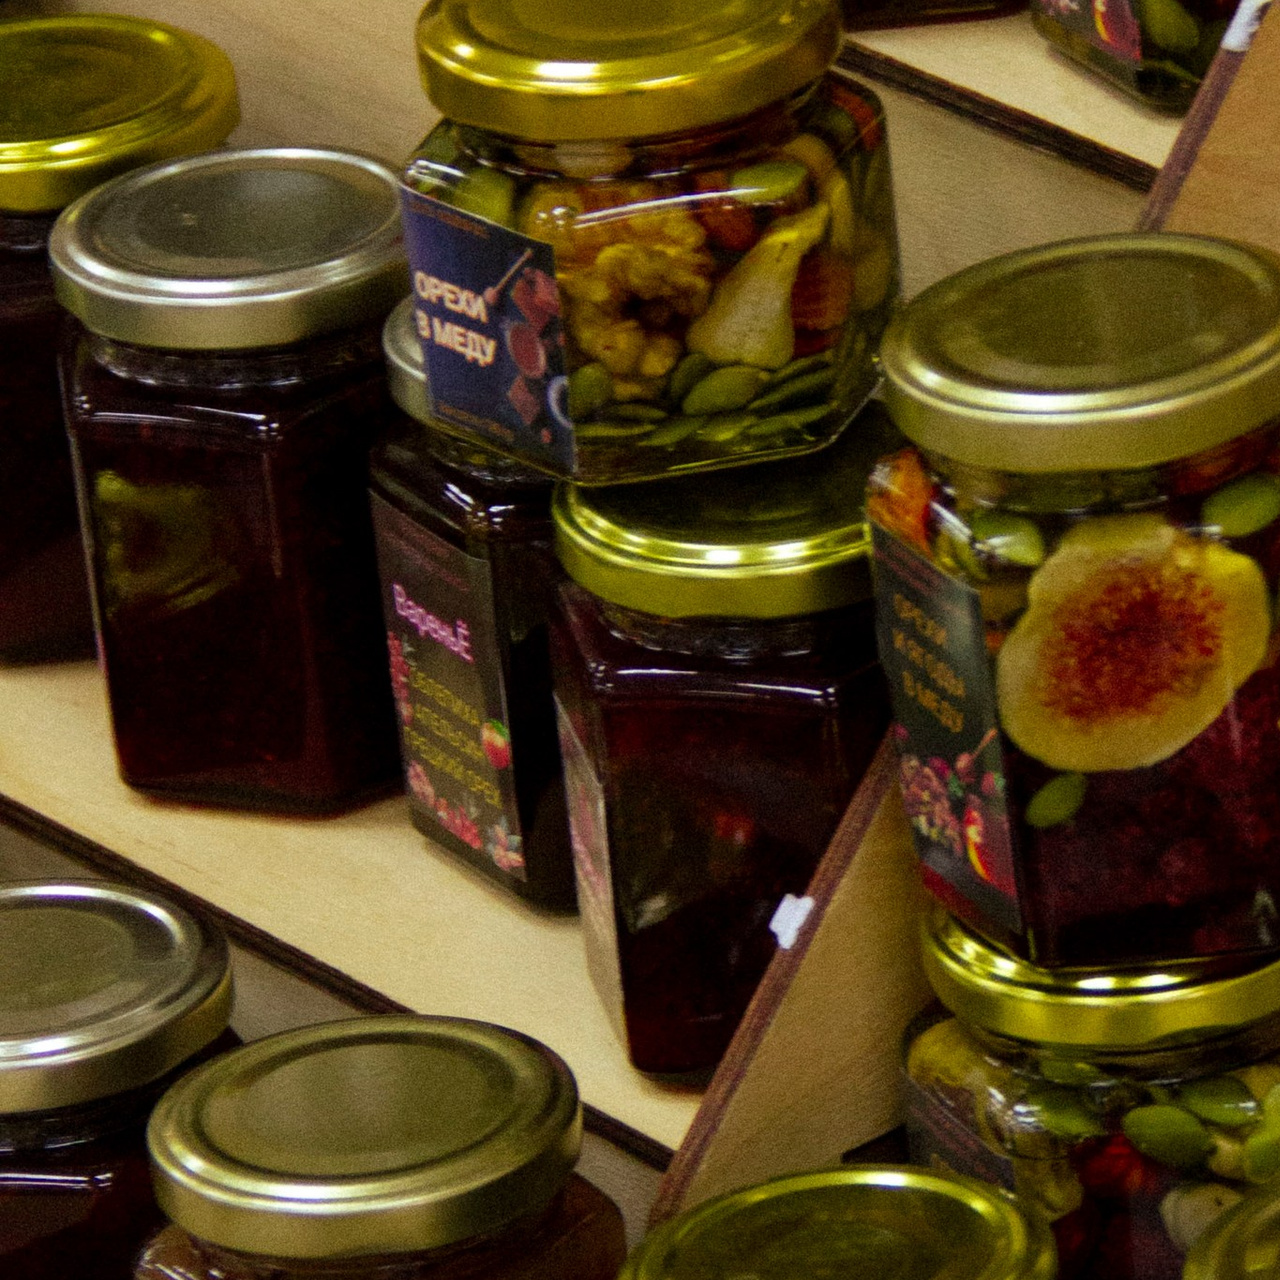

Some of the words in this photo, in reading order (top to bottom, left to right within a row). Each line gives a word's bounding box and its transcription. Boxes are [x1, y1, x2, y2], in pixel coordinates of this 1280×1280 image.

[414, 270, 489, 325] ОРЕХИ
[415, 308, 432, 341] В
[431, 316, 499, 368] МЕДУ
